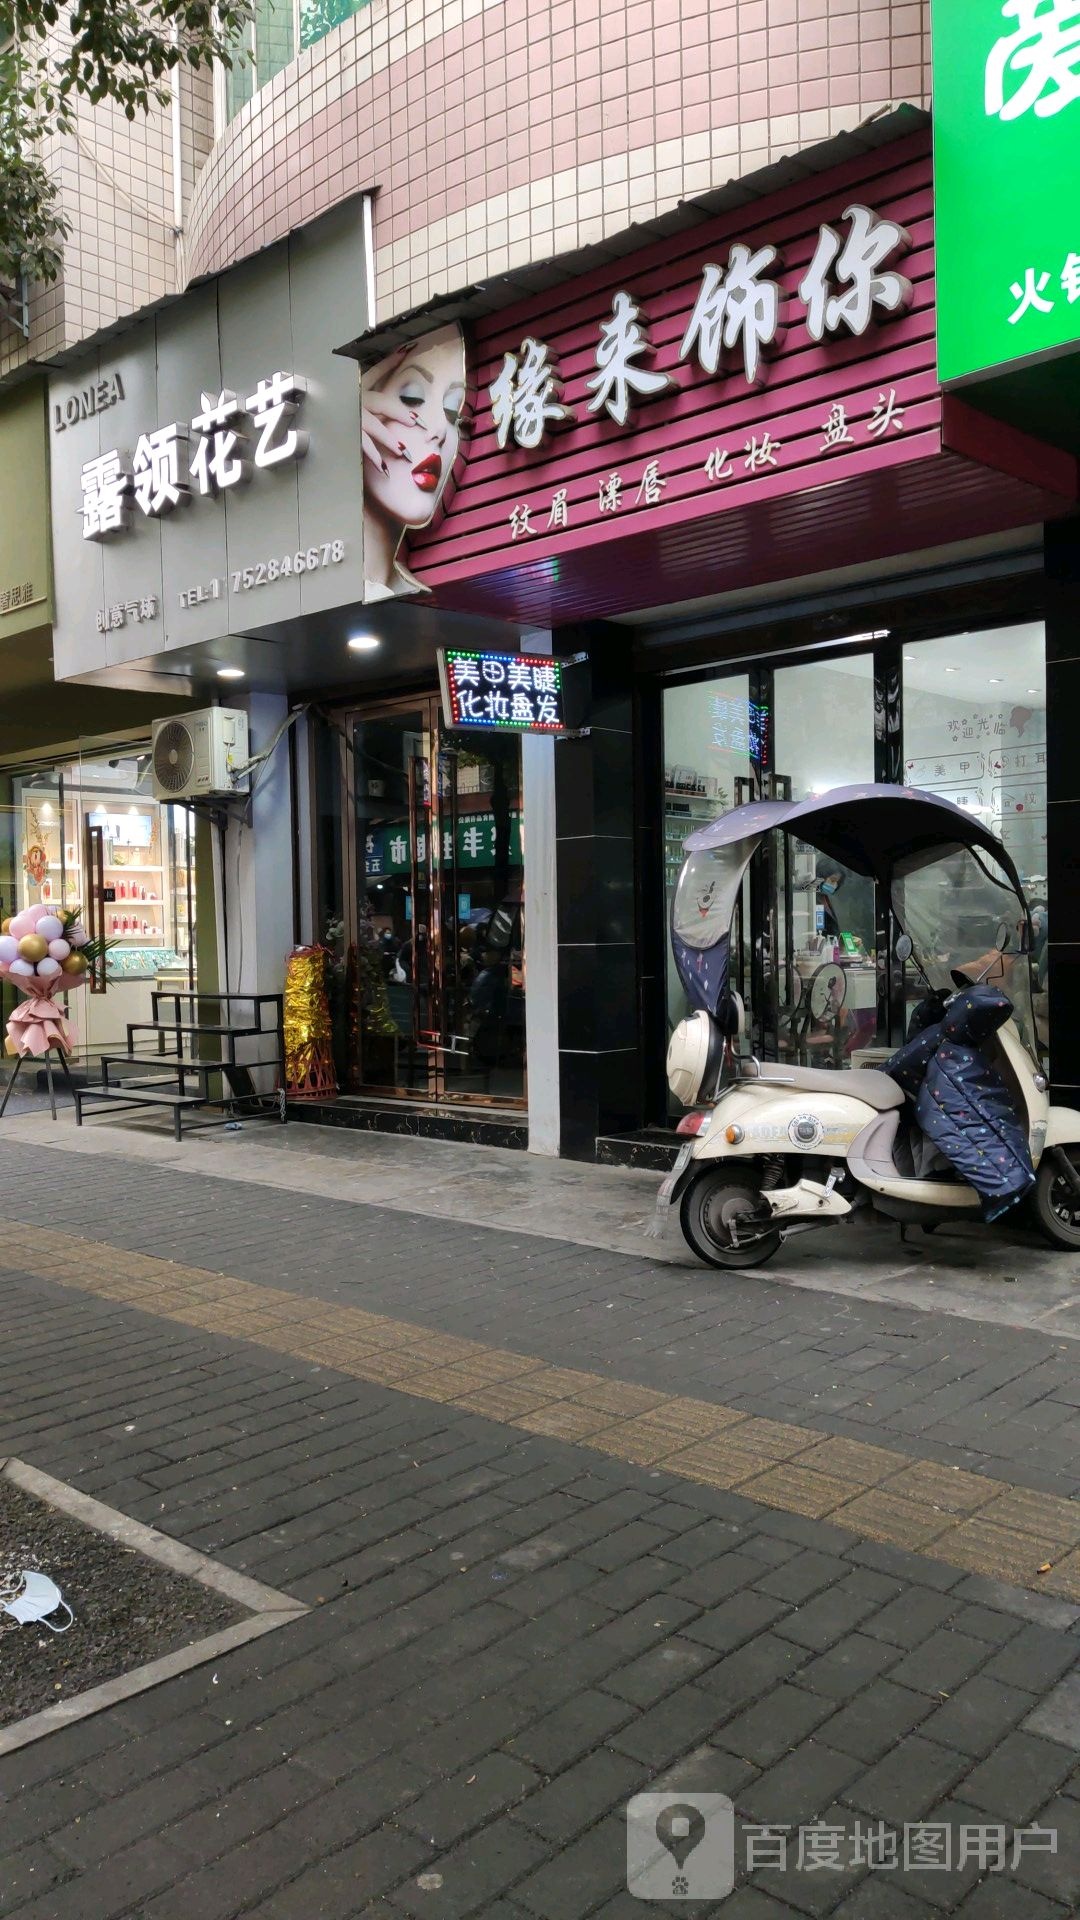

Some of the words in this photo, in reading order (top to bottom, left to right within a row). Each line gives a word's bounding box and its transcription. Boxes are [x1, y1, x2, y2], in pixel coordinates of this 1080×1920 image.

[489, 204, 909, 449] 缘来饰你
[55, 373, 125, 432] LONEA
[80, 372, 306, 540] 露领花艺
[509, 488, 568, 540] 纹眉
[598, 459, 667, 512] 漂唇
[704, 432, 781, 480] 化妆
[820, 388, 905, 452] 盘头
[456, 689, 560, 724] 化妆盘发
[947, 718, 1007, 739] 欢迎光临
[934, 761, 971, 777] 美甲
